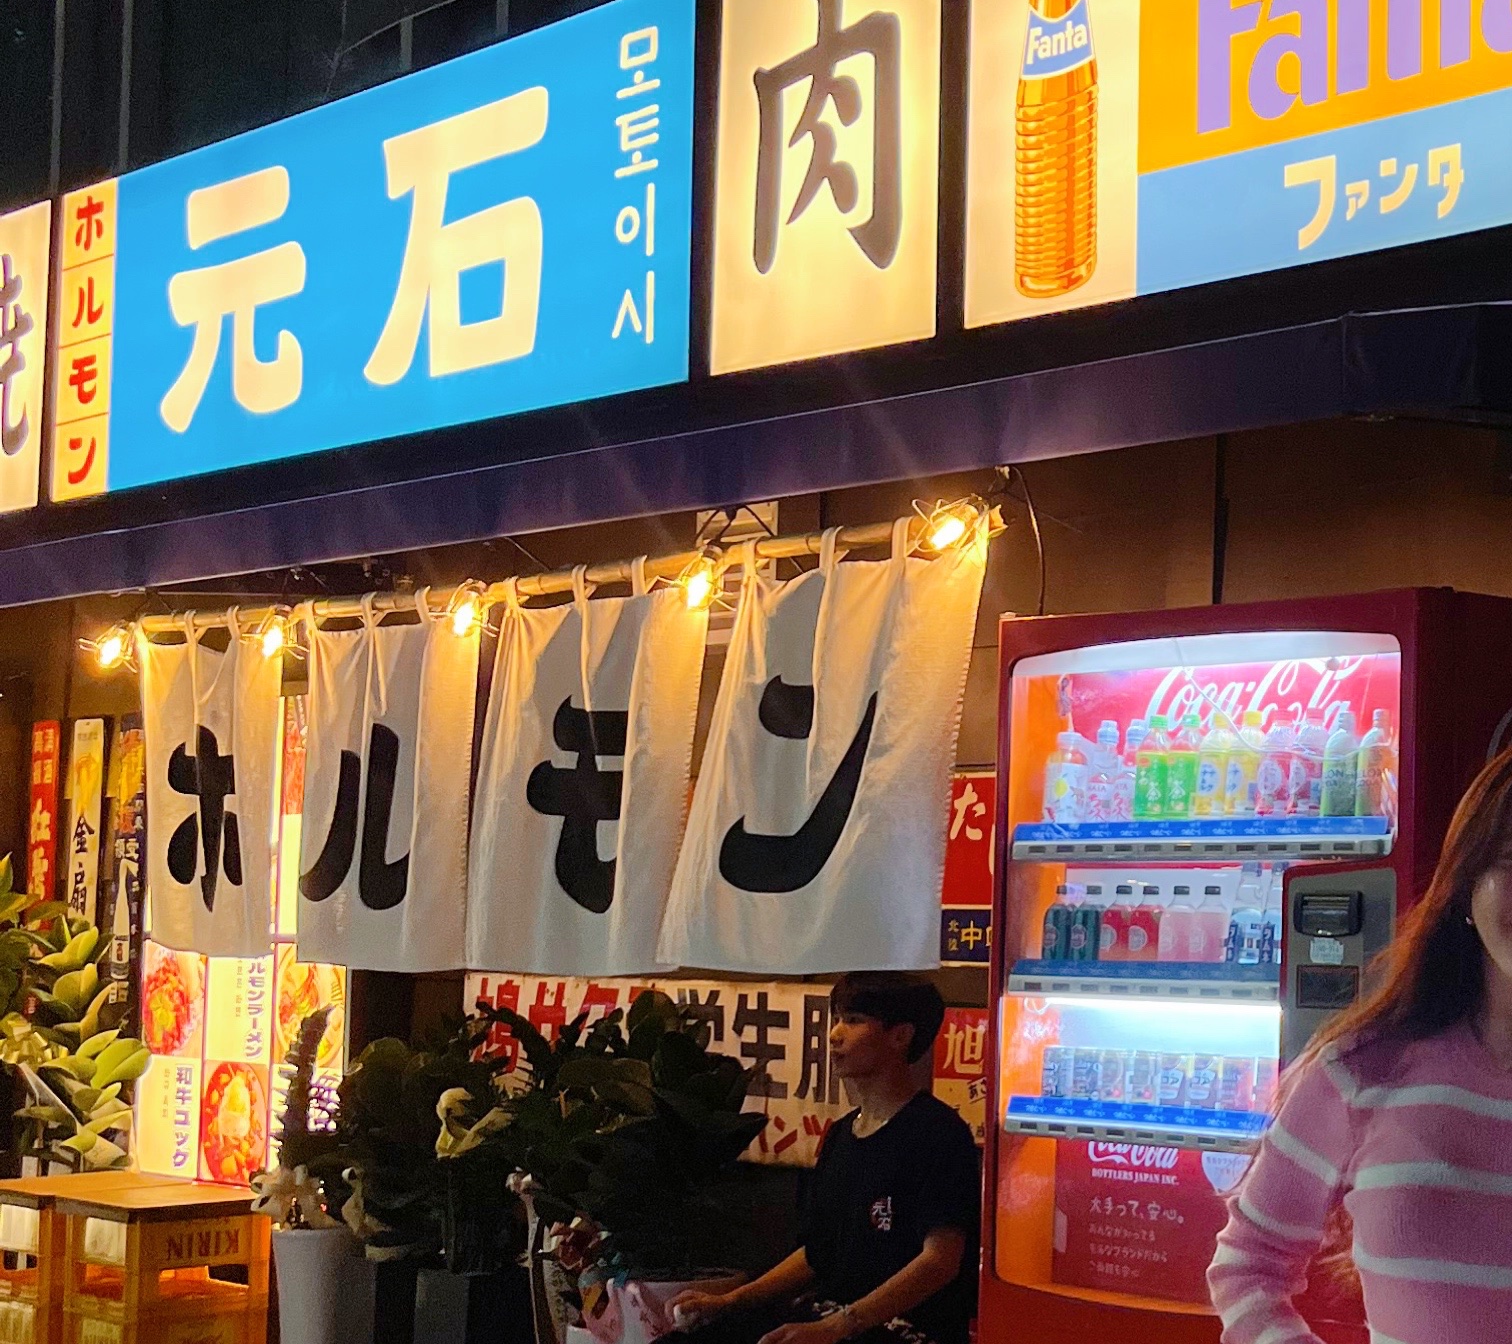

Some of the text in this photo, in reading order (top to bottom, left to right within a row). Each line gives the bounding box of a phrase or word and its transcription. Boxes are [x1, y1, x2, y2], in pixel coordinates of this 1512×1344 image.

[1026, 20, 1090, 66] Fanta
[611, 26, 661, 345] 모토이시
[1284, 145, 1465, 252] ファンタ
[160, 85, 549, 434] 元石
[67, 196, 105, 485] ホルモン
[167, 672, 878, 916] ホルモン
[245, 956, 268, 1058] ルモンラーメン
[942, 1022, 986, 1075] 旭
[1091, 1167, 1133, 1181] BOTTLERS
[1133, 1172, 1160, 1184] JAPAN
